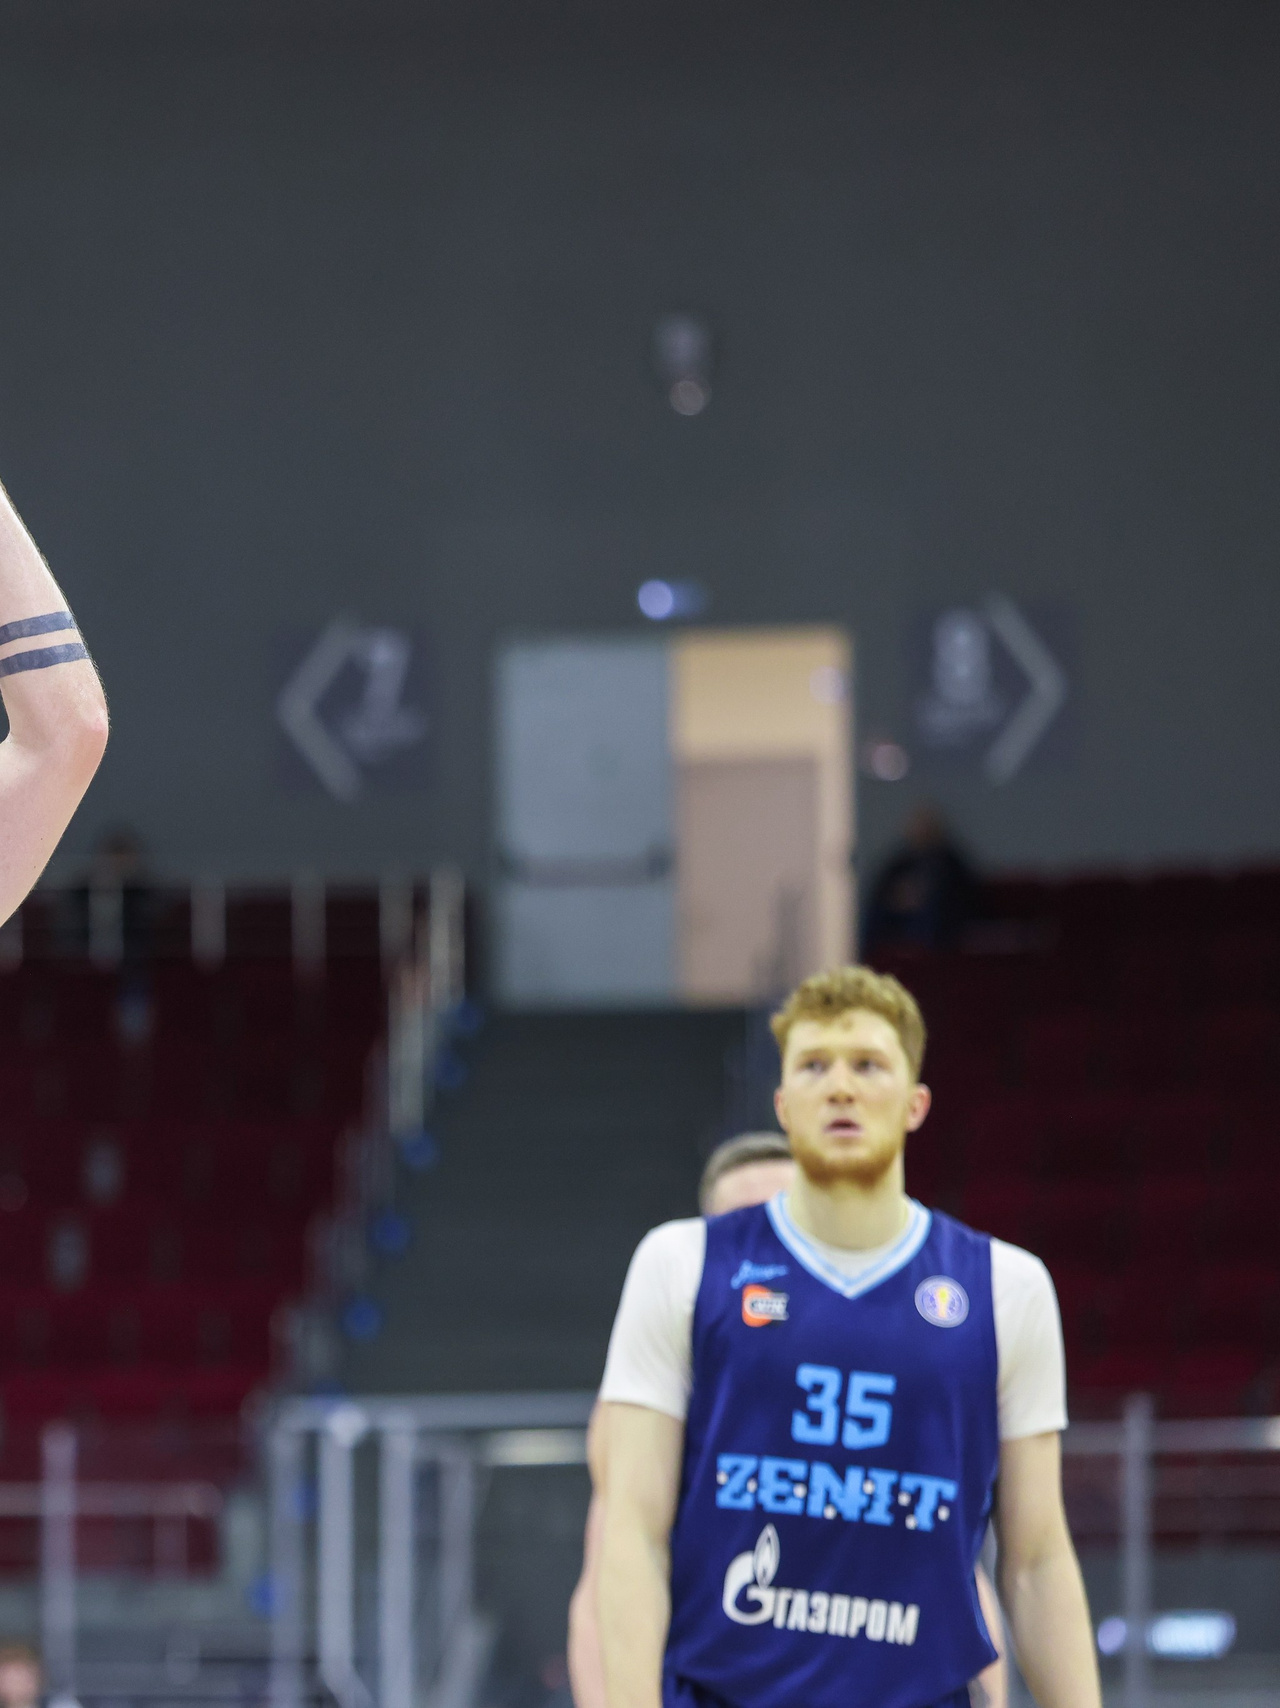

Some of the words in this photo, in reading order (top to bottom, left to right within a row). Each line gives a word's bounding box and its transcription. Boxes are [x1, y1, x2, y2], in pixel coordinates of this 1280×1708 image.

[791, 1363, 897, 1450] 35
[717, 1453, 958, 1534] ZENIT
[773, 1587, 920, 1647] ГАЗПРОМ
